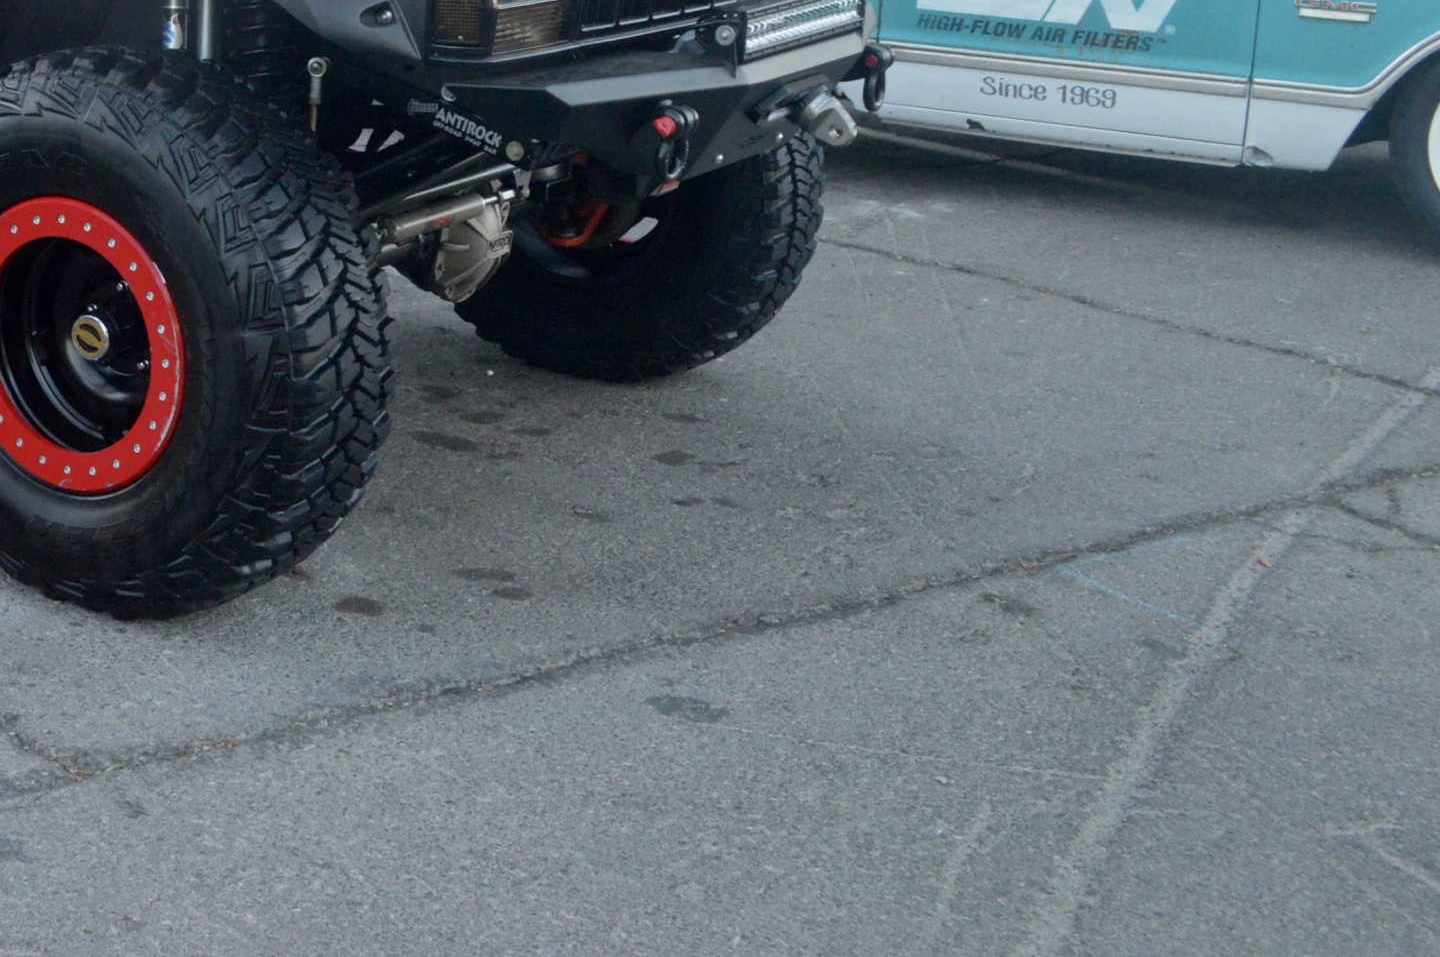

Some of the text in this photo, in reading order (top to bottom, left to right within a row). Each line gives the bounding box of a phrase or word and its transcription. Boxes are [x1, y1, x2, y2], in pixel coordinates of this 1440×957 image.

[1031, 25, 1065, 44] AIR
[979, 76, 1118, 109] Since 1969
[435, 107, 502, 148] ANTIROCK
[483, 144, 498, 156] BAR
